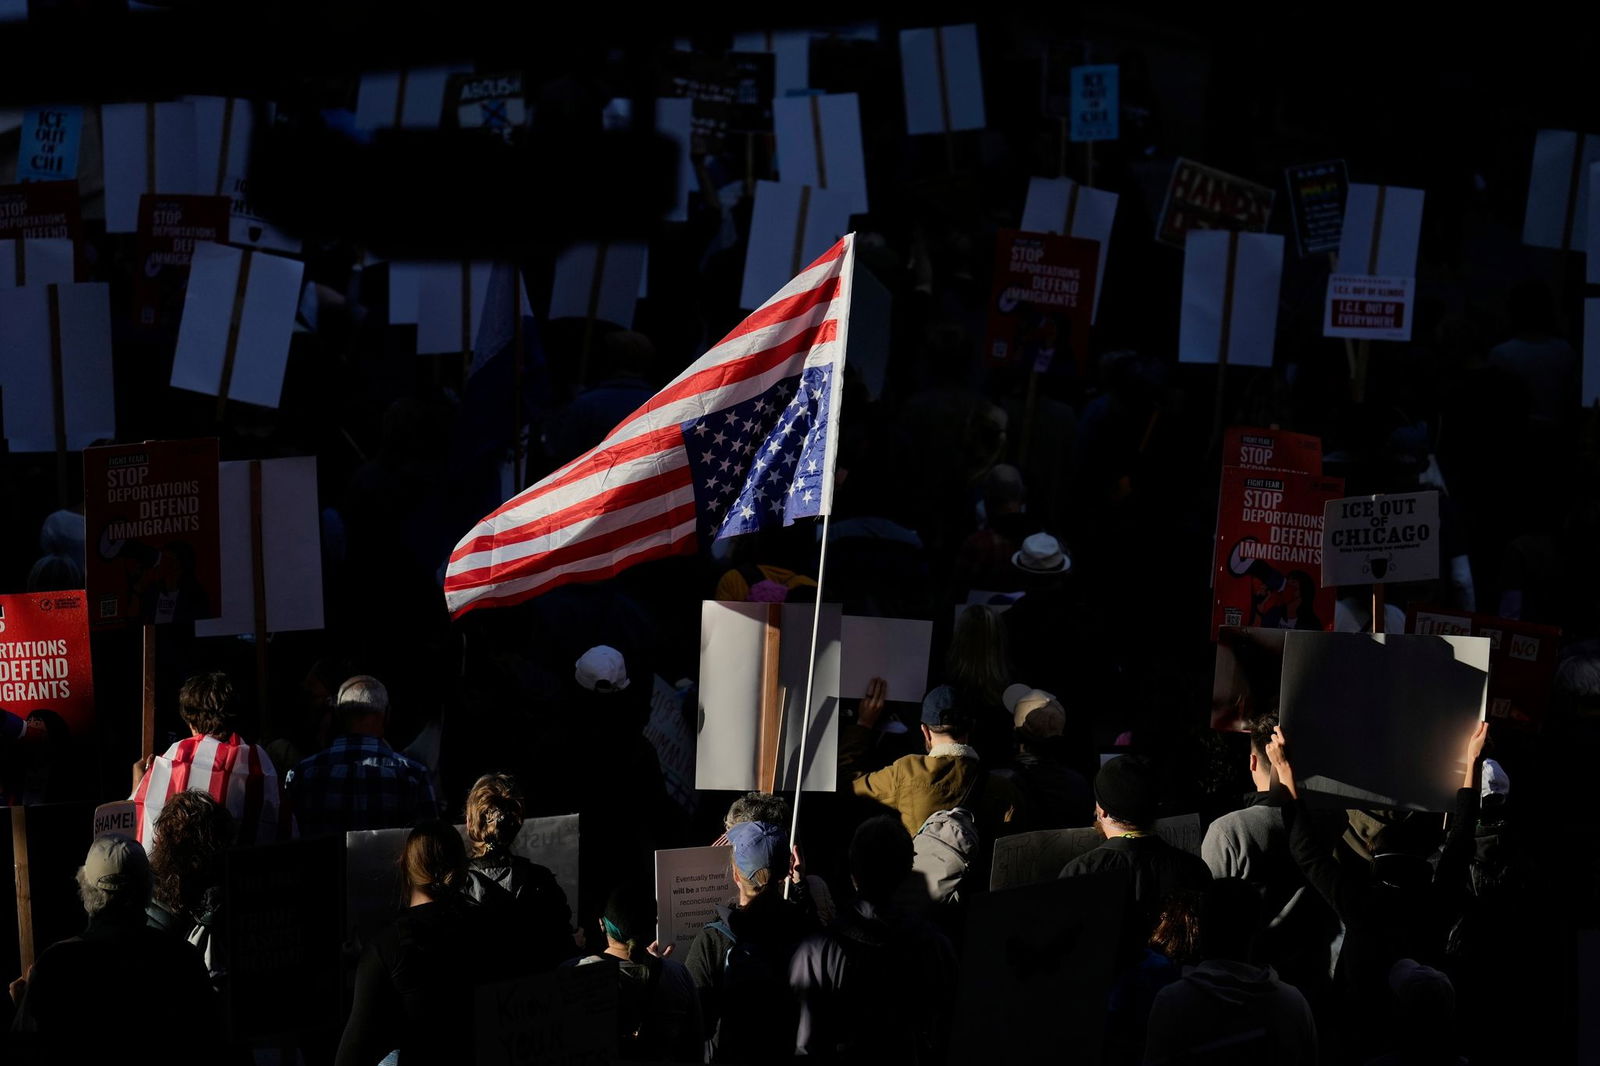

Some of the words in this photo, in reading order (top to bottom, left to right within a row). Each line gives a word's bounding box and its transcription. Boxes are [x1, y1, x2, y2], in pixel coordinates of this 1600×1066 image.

[152, 210, 183, 226] STOP
[173, 238, 195, 252] DEF
[1011, 246, 1044, 262] STOP
[1009, 261, 1081, 280] DEPORTATIONS
[1032, 276, 1079, 293] DEFEND
[1006, 288, 1078, 308] IMMIGRANTS
[1365, 302, 1383, 314] OUT
[1385, 303, 1396, 315] OF
[1338, 314, 1395, 328] EVERYWHERE
[1240, 446, 1273, 465] STOP
[107, 466, 149, 488] STOP
[1265, 480, 1281, 489] FEAR
[107, 480, 200, 504] DEPORTATIONS
[1243, 489, 1283, 510] STOP
[140, 496, 200, 520] DEFEND
[1343, 501, 1374, 518] ICE
[1380, 499, 1416, 516] OUT
[108, 515, 200, 540] IMMIGRANTS
[1242, 508, 1324, 529] DEPORTATIONS
[1370, 516, 1388, 527] OF
[1270, 526, 1322, 548] DEFEND
[1331, 524, 1429, 547] CHICAGO
[1240, 541, 1322, 565] IMMIGRANTS
[0, 639, 67, 658] RTATIONS
[0, 657, 69, 682] DEFEND
[0, 679, 71, 702] GRANTS
[95, 811, 134, 835] SHAME!
[675, 874, 707, 883] Eventually
[679, 896, 722, 906] reconciliation
[675, 909, 714, 918] commission
